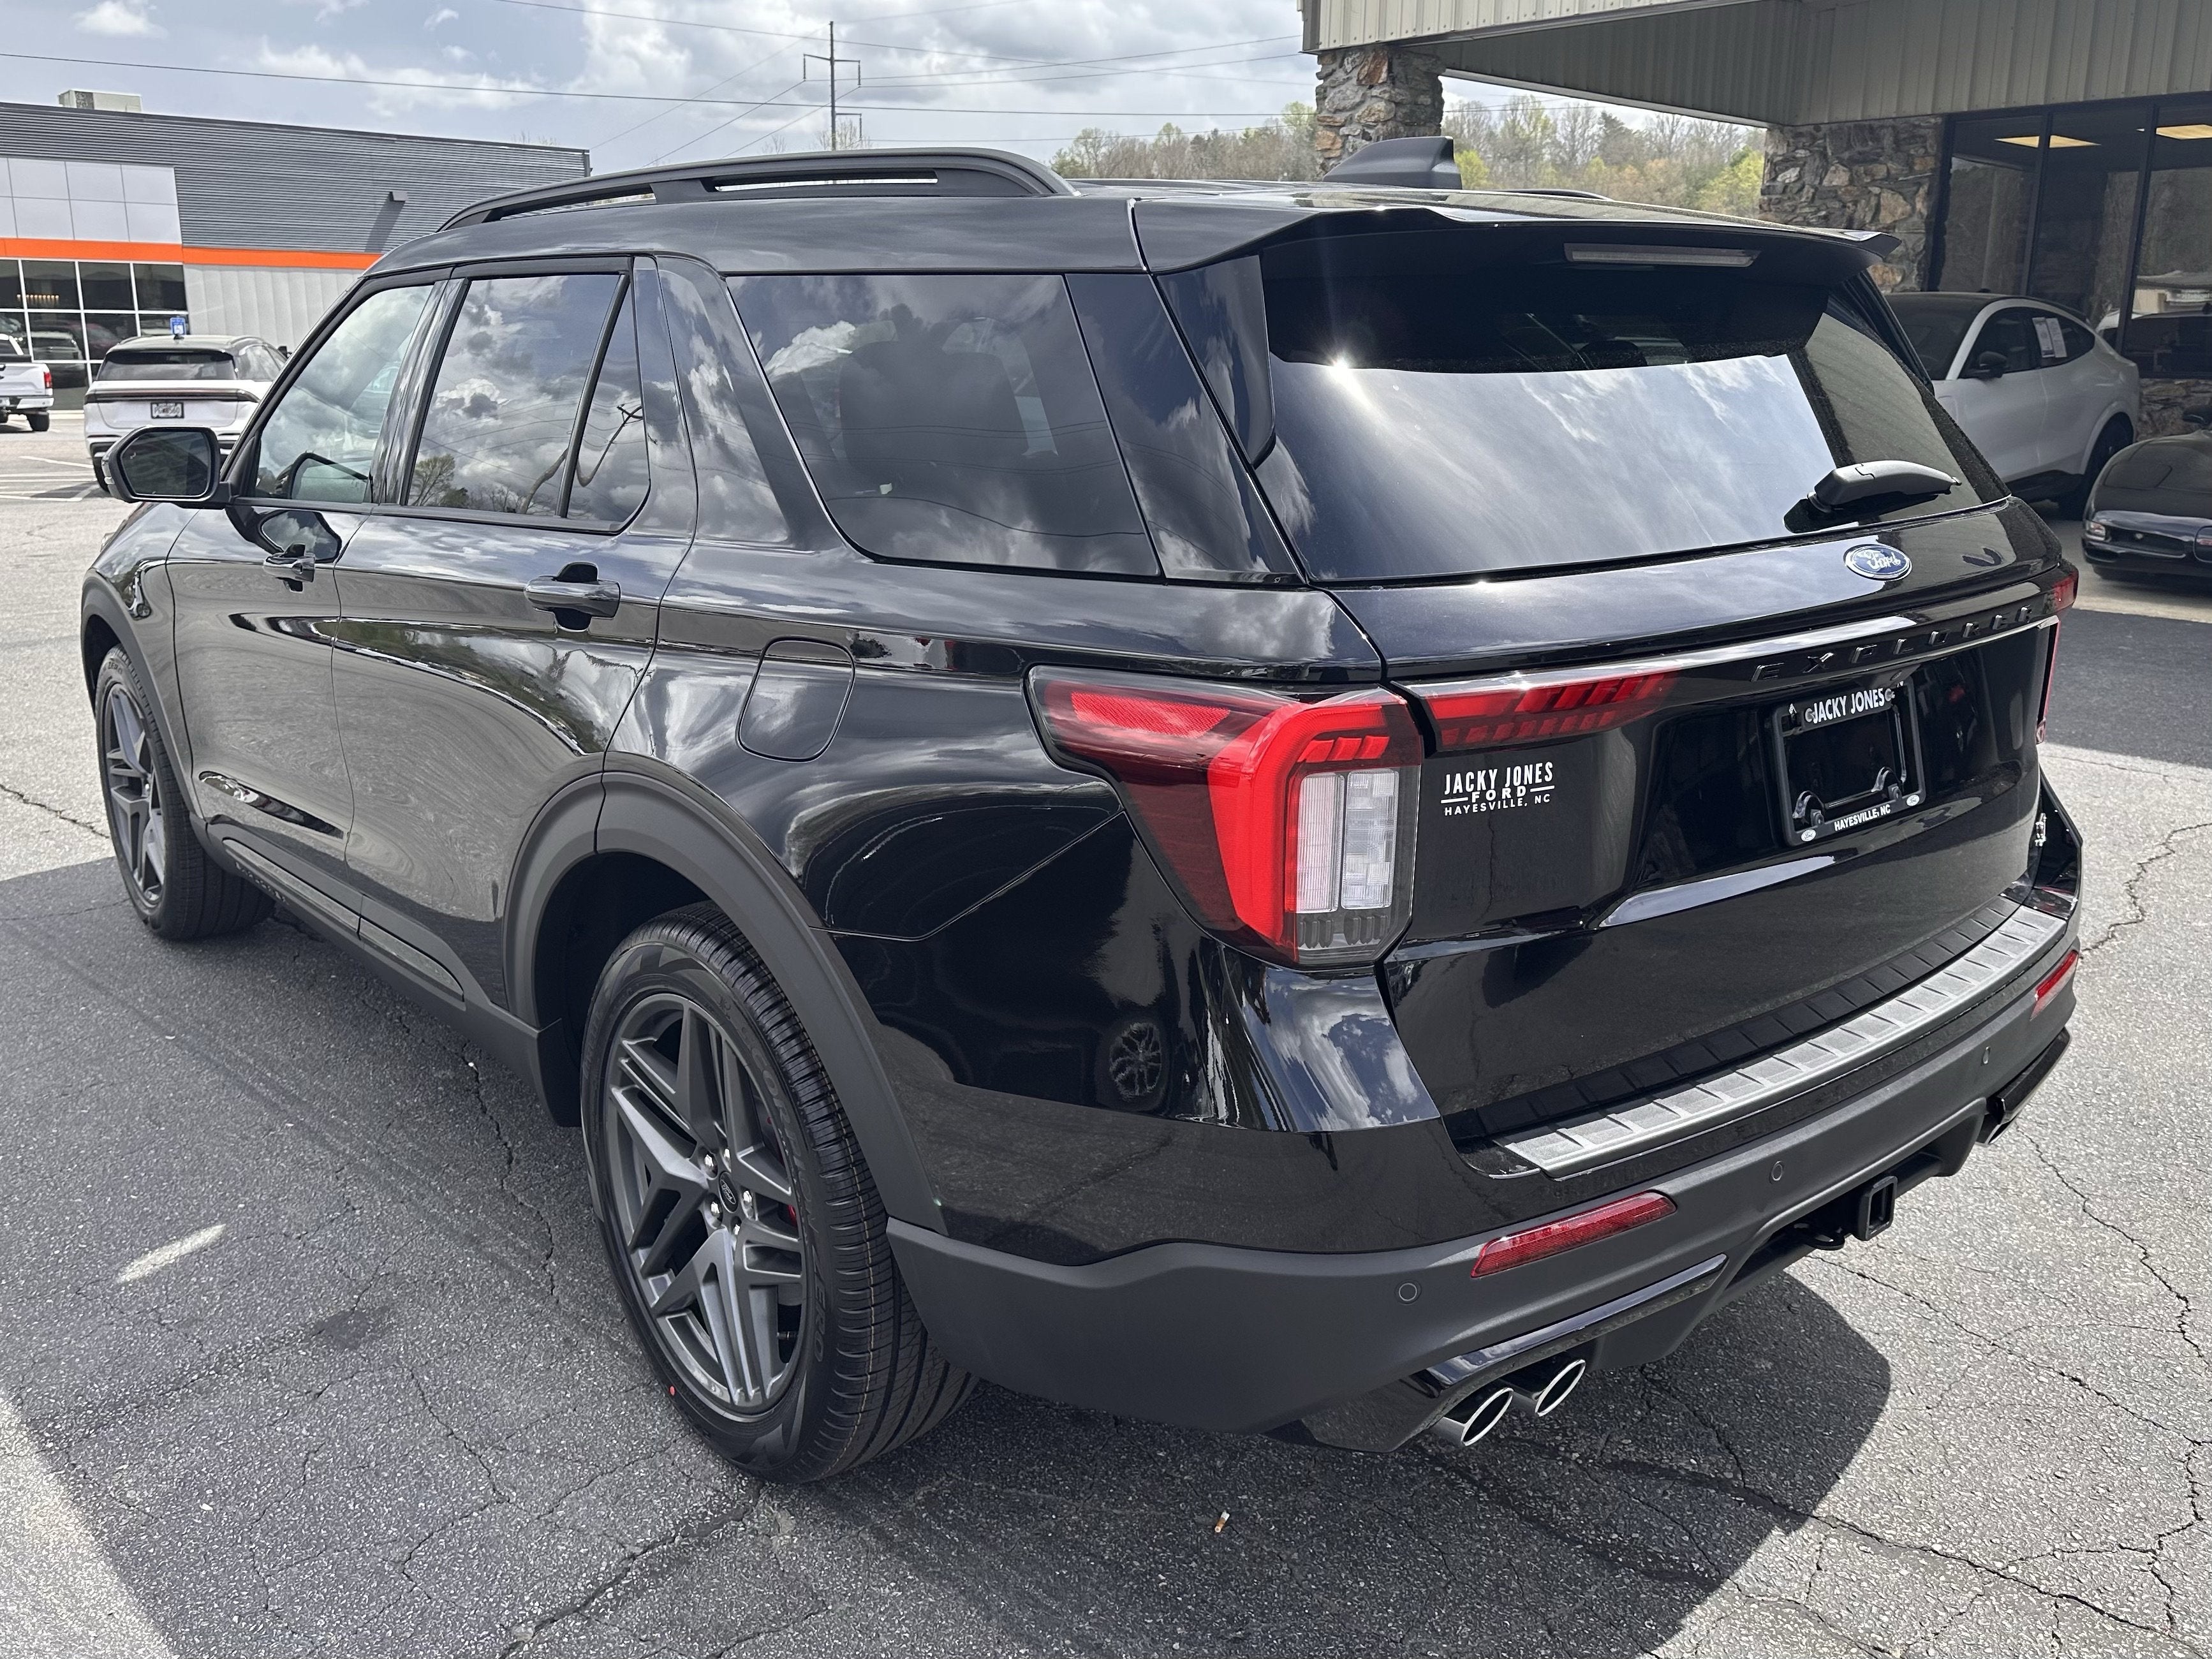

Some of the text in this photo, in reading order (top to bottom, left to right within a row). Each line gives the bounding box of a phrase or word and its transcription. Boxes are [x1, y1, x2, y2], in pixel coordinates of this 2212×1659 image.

[1852, 547, 1903, 572] Ford
[1750, 605, 2033, 682] EXPLORER
[1813, 688, 1885, 724] JACKY JONES
[1444, 761, 1553, 795] JACKY JONES
[1445, 793, 1551, 816] HAYESVILLE, NC
[1471, 785, 1526, 803] FORD
[1834, 804, 1891, 832] HAYESVILLE, NC
